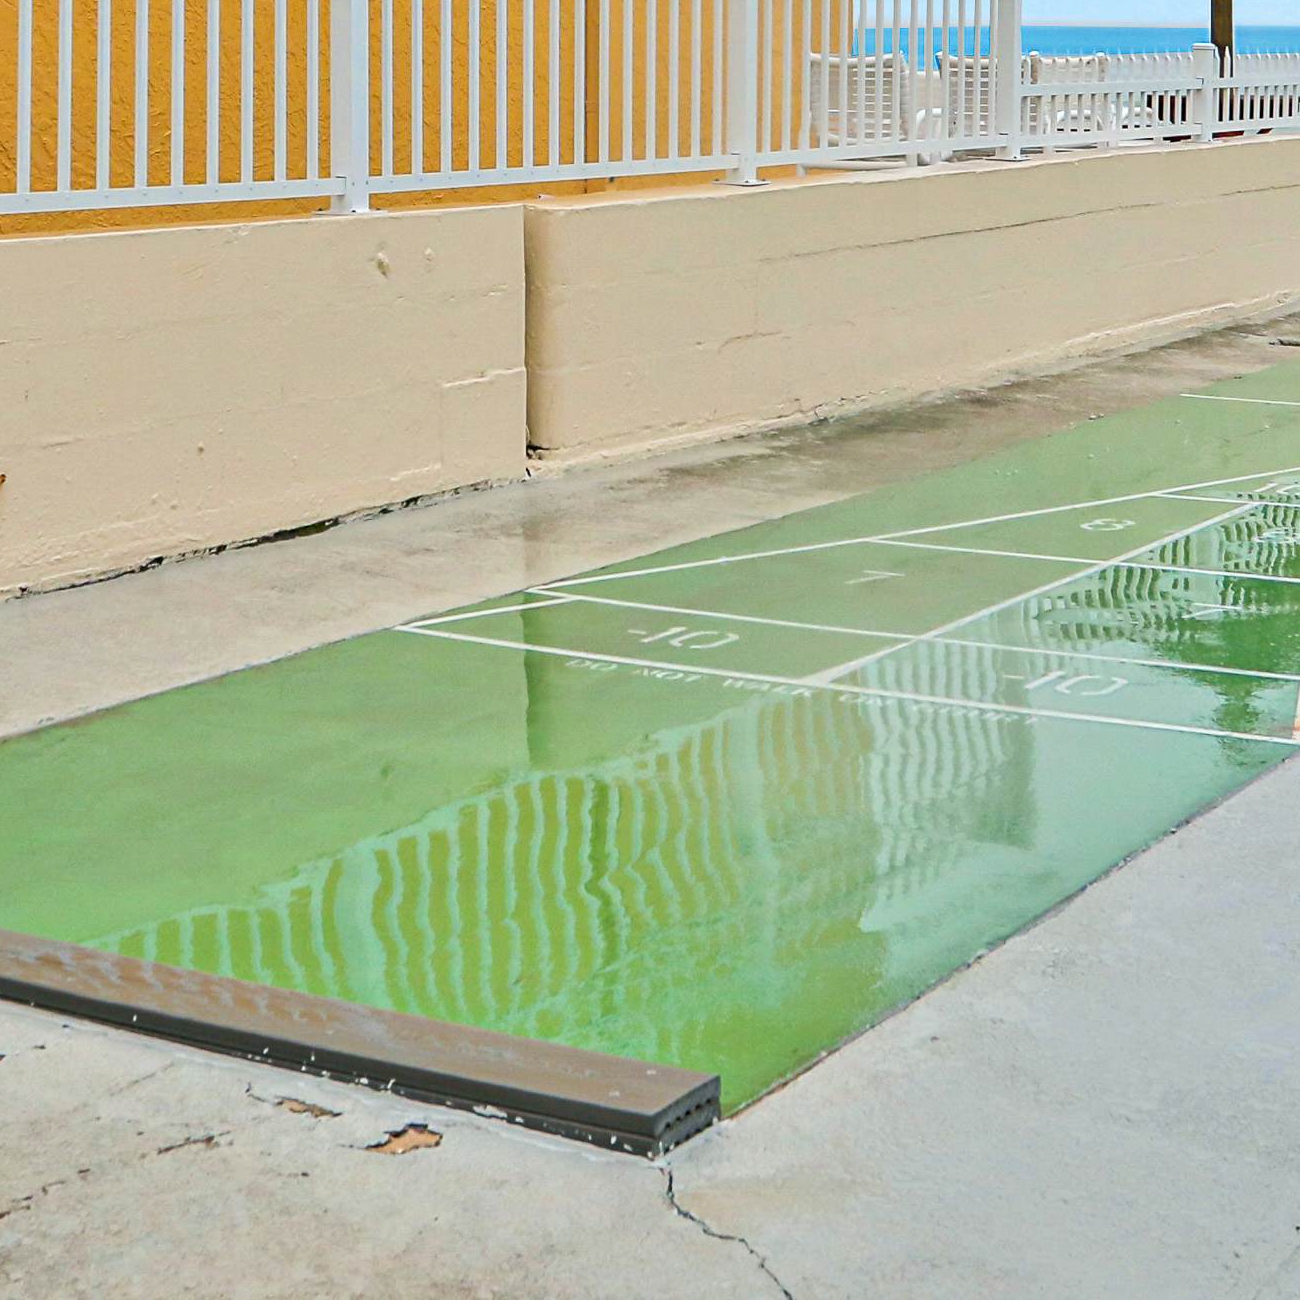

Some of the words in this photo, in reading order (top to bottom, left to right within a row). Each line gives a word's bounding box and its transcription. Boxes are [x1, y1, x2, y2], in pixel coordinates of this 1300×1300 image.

[1080, 518, 1136, 531] 8
[844, 569, 906, 584] 7
[1181, 602, 1244, 619] 7
[627, 626, 739, 649] -10
[1003, 670, 1128, 696] -10
